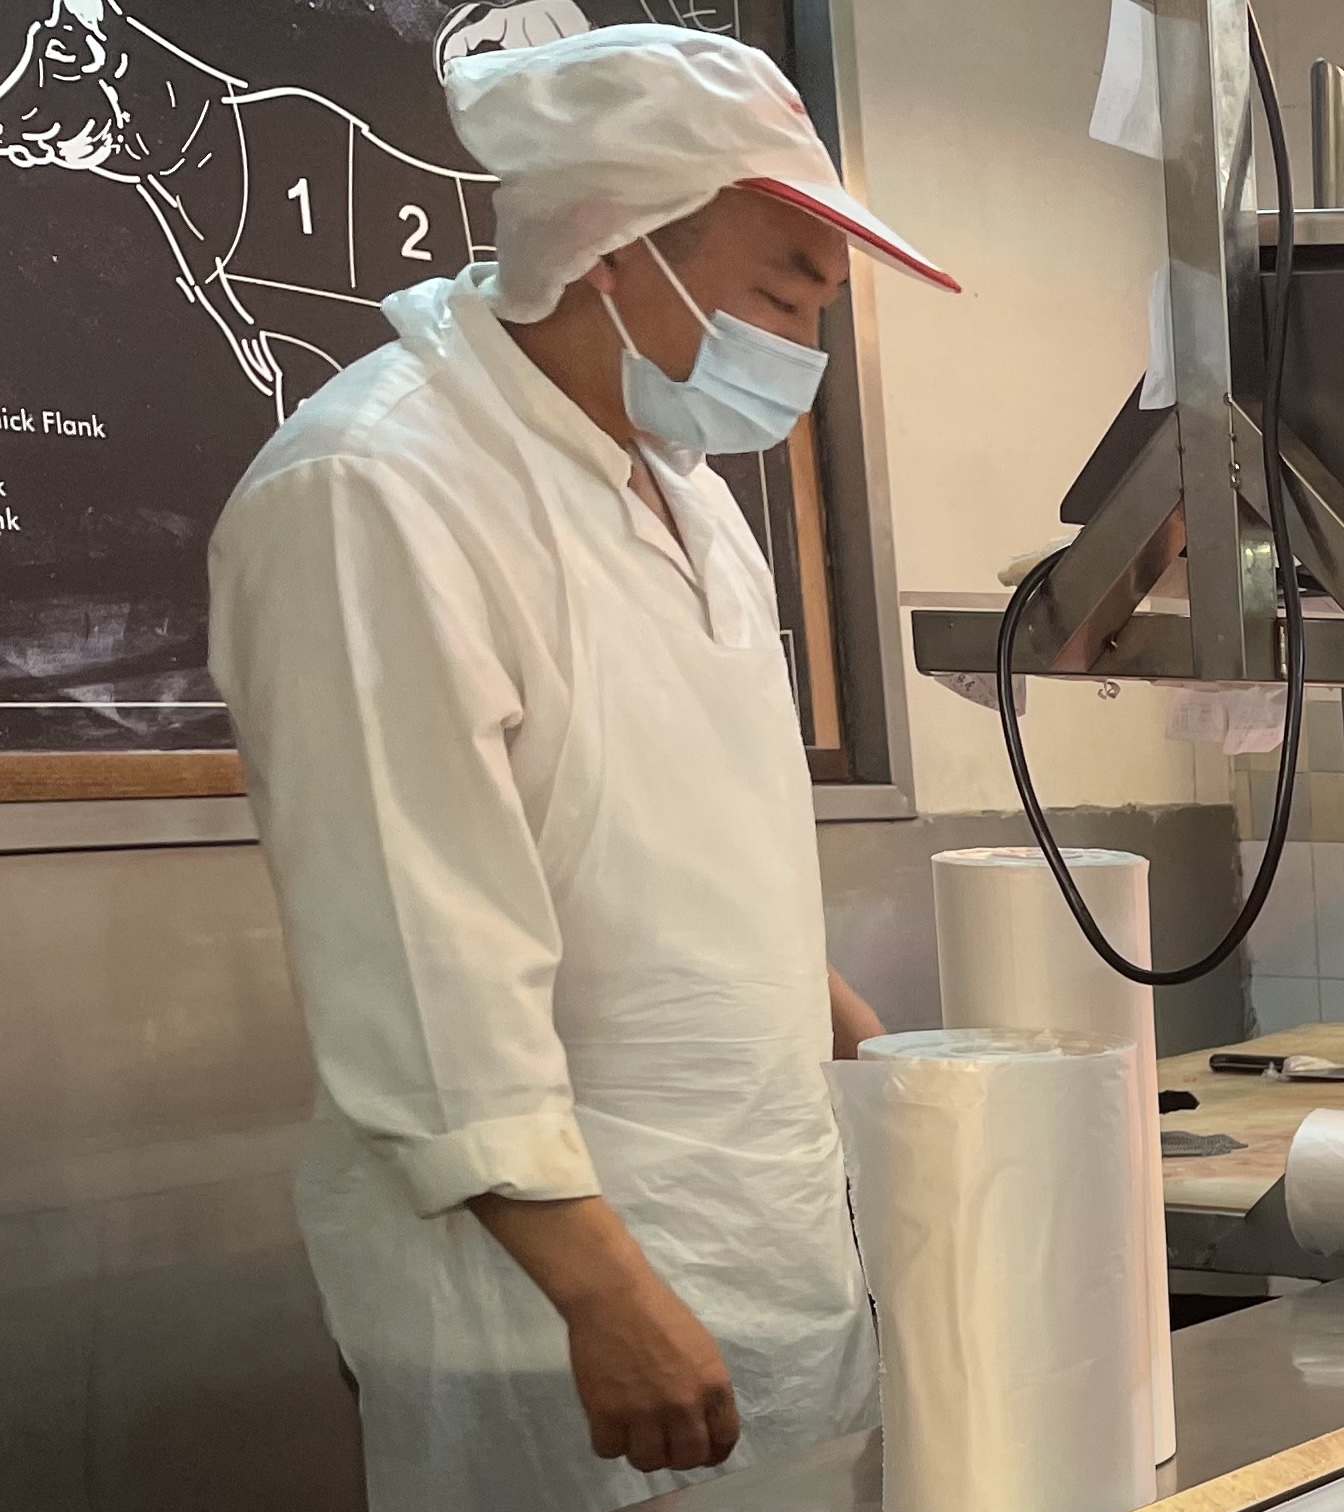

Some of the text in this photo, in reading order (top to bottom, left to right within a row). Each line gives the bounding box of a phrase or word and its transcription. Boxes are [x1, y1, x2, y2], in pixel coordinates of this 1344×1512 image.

[287, 178, 314, 235] 1
[398, 204, 432, 261] 2
[0, 407, 108, 438] ick Flank
